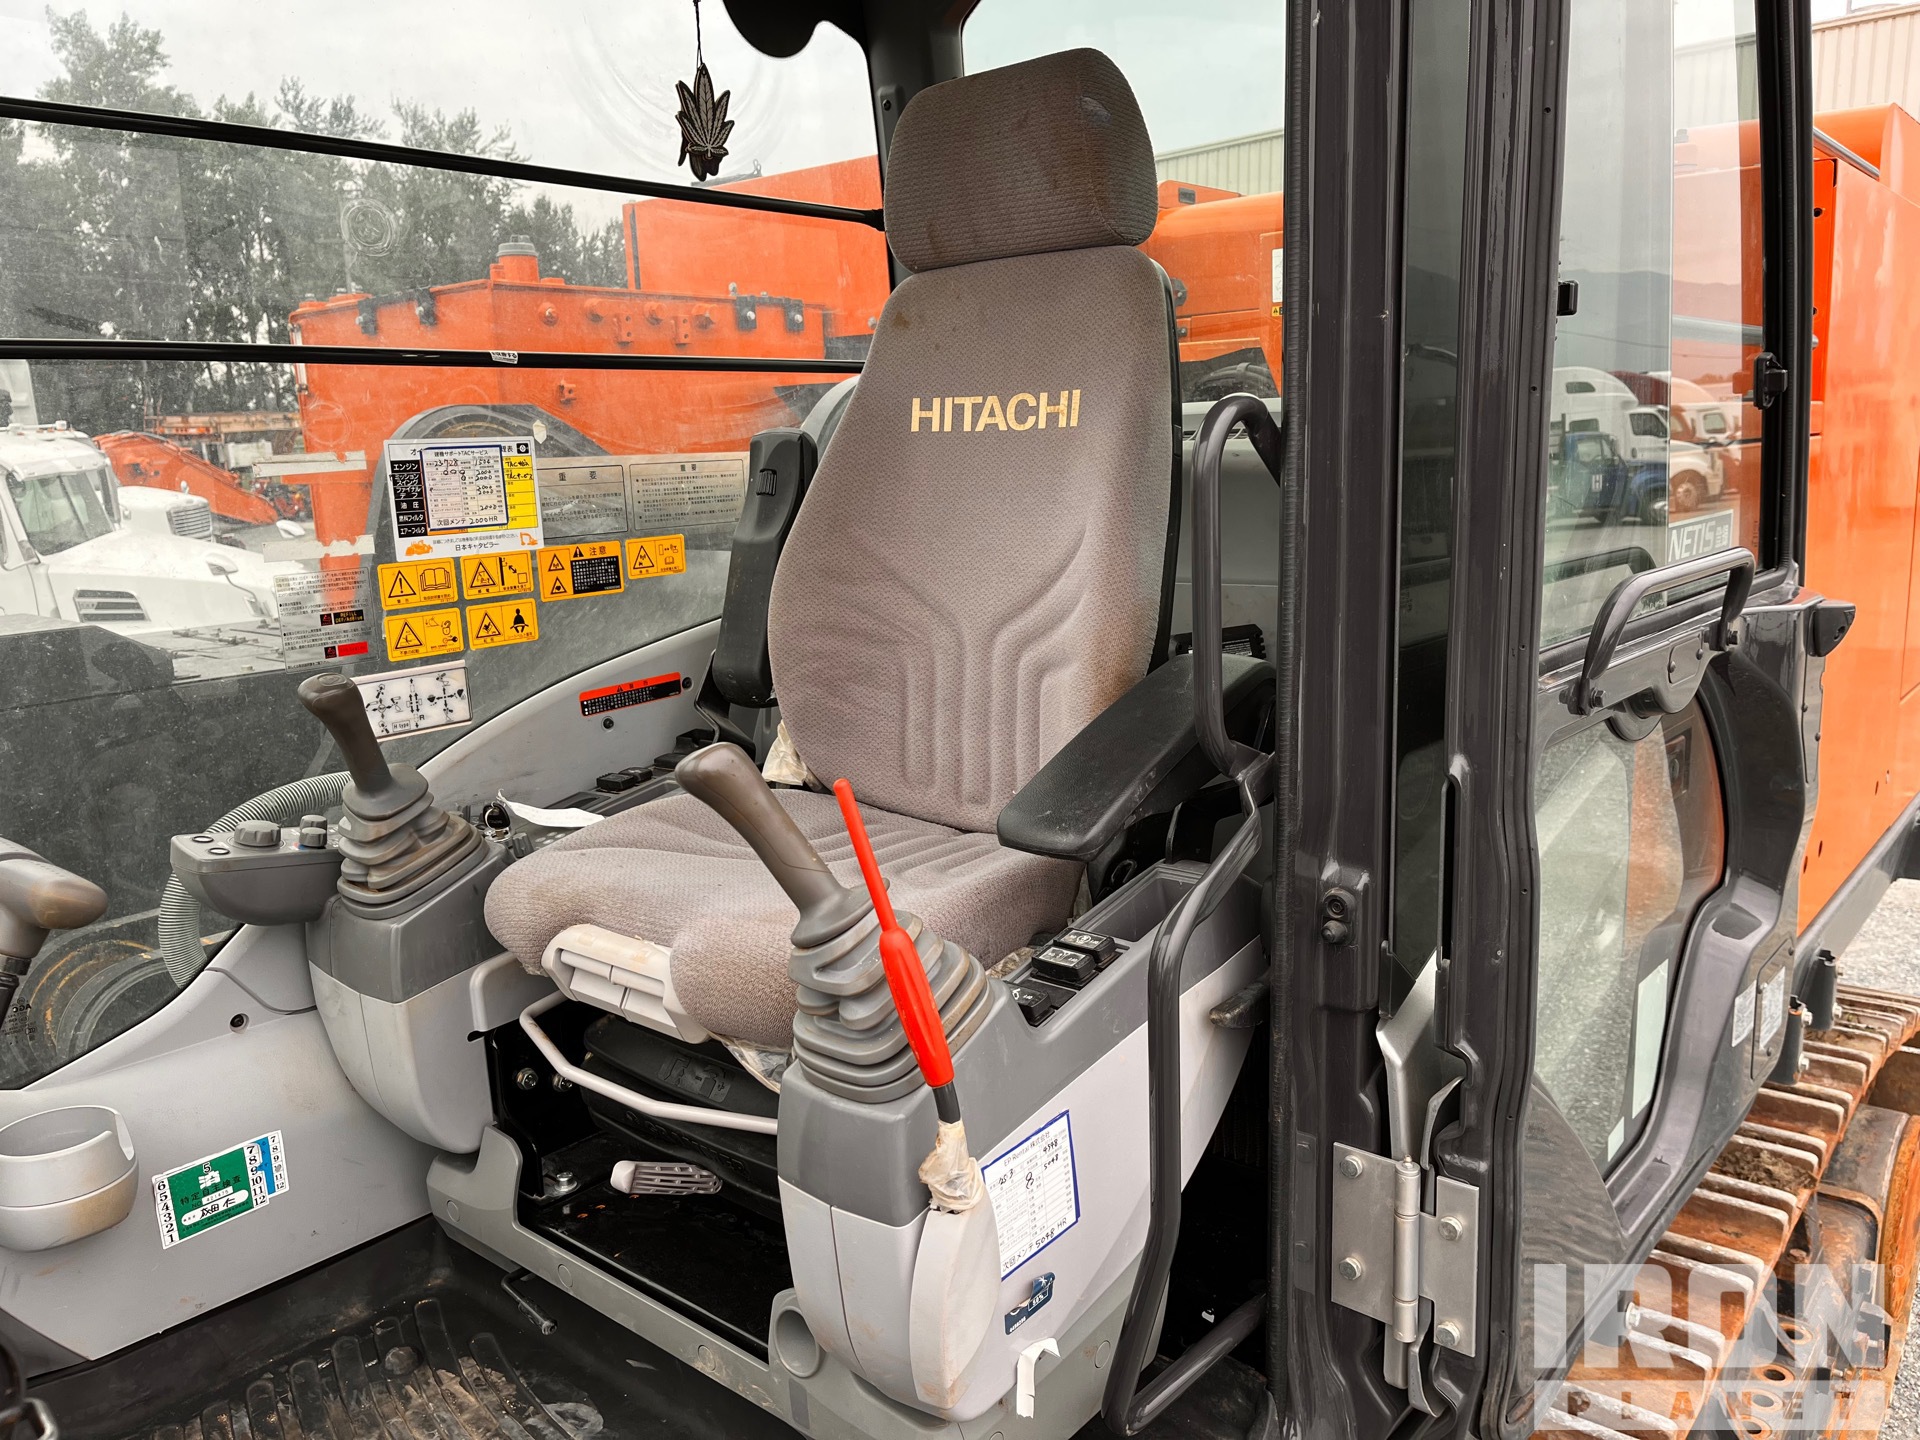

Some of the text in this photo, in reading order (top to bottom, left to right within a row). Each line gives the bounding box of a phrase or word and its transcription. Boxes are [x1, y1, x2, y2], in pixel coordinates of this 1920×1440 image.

[911, 389, 1081, 432] HITACHI
[393, 463, 418, 471] エンジン
[455, 541, 500, 551] 日本キャタピラー
[1668, 520, 1716, 563] NETIS
[589, 545, 607, 556] 注意
[246, 1145, 255, 1155] 7
[248, 1155, 257, 1165] 8
[203, 1162, 211, 1173] 5
[250, 1166, 258, 1175] 9
[251, 1175, 263, 1186] 10
[157, 1181, 166, 1191] 6
[180, 1175, 241, 1205] 特定自主検査
[252, 1186, 263, 1196] 11
[159, 1192, 168, 1202] 5
[254, 1195, 266, 1206] 12
[161, 1202, 170, 1212] 4
[163, 1213, 172, 1223] 3
[165, 1223, 174, 1233] 2
[168, 1233, 174, 1243] 1
